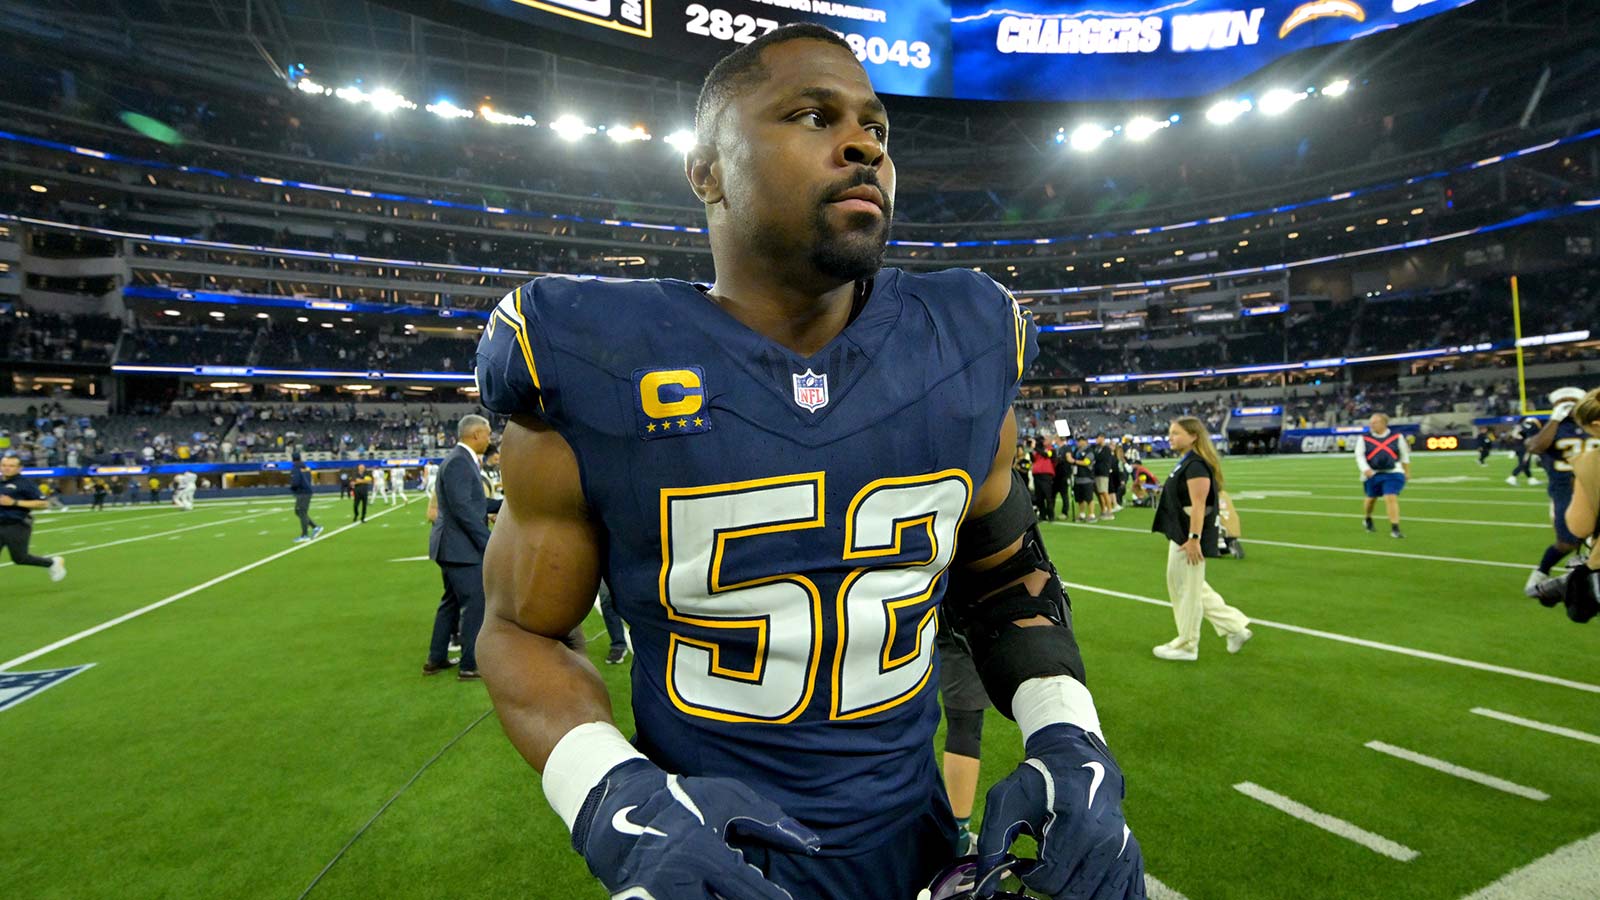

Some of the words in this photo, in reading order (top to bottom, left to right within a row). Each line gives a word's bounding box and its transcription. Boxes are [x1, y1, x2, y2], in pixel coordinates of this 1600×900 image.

[813, 1, 887, 23] NUMBER
[996, 16, 1163, 54] CHARGERS
[1172, 8, 1265, 51] WIN
[639, 369, 703, 420] C
[800, 388, 824, 405] NFL
[659, 468, 973, 724] 52
